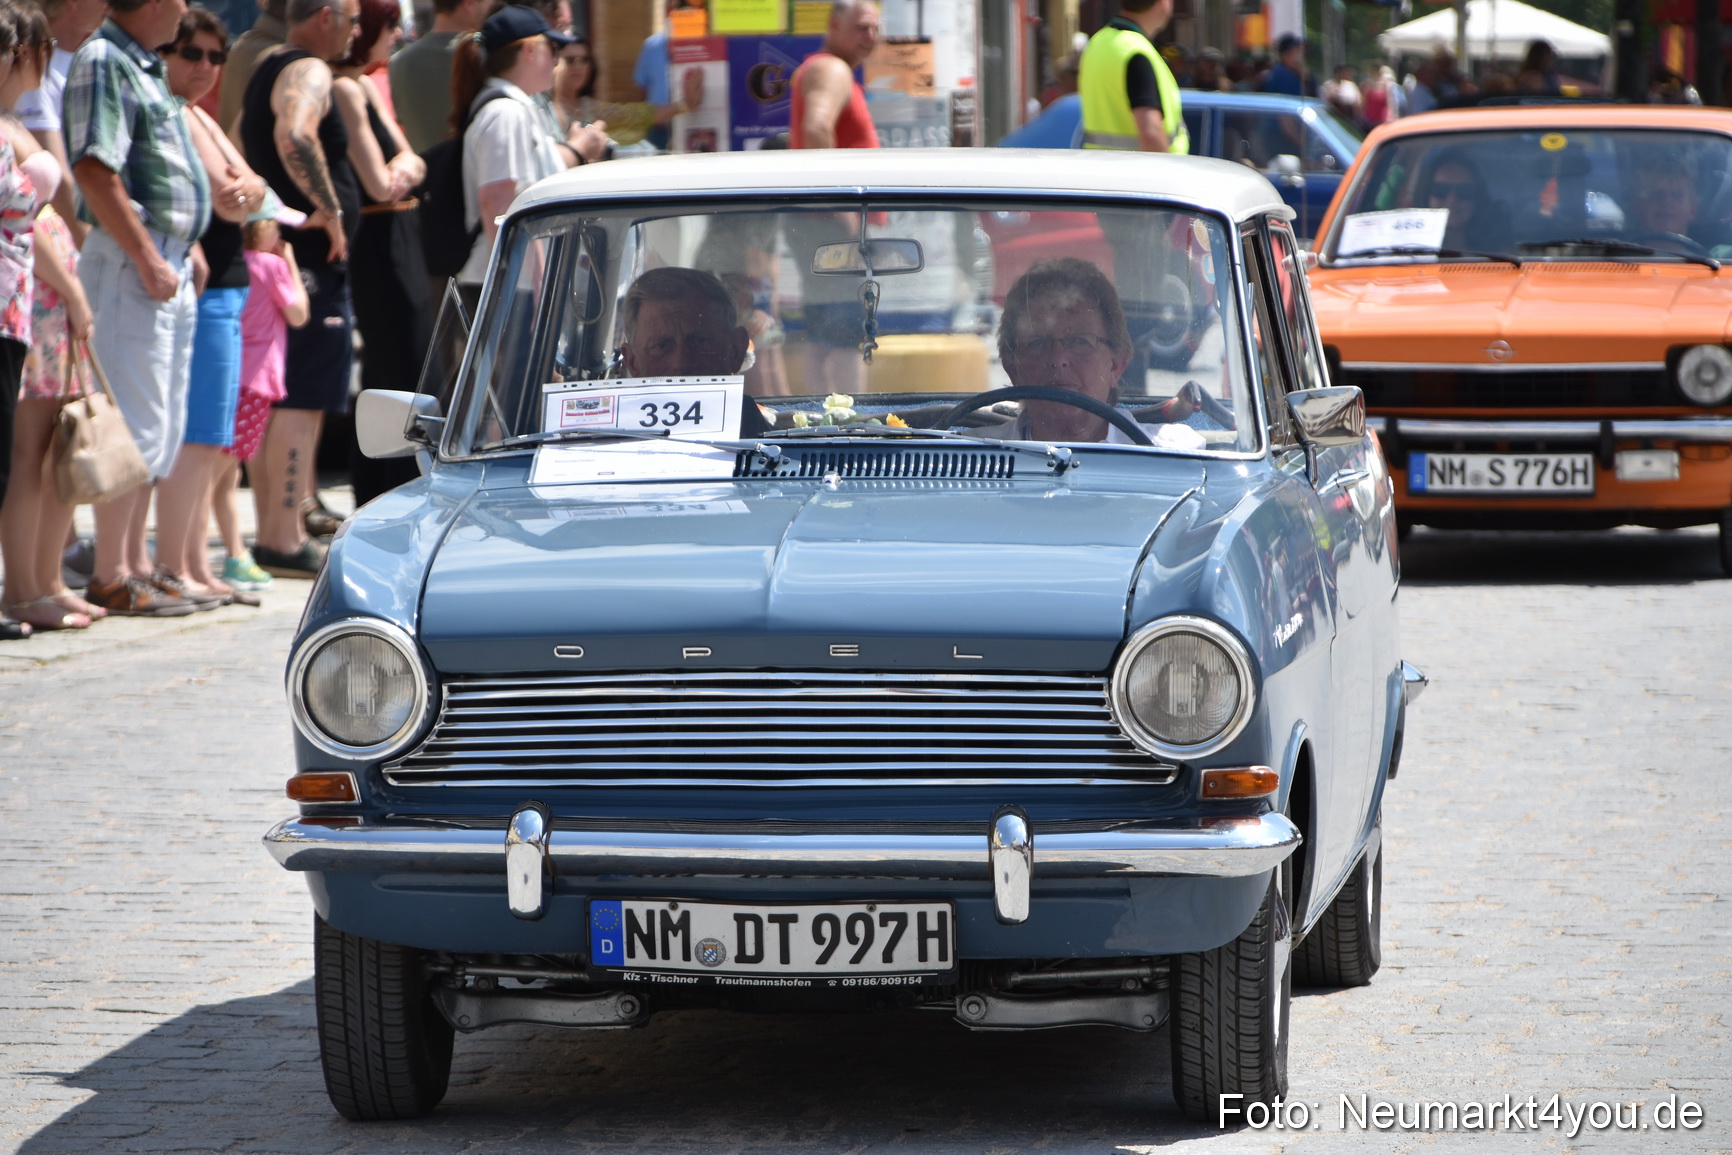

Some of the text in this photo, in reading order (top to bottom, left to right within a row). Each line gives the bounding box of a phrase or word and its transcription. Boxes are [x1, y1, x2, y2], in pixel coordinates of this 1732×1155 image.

[639, 400, 703, 427] 334
[1428, 458, 1466, 485] NM
[1488, 458, 1506, 486] S
[1514, 458, 1589, 486] 776H
[553, 644, 984, 659] OPEL
[601, 939, 613, 954] D
[625, 908, 691, 962] NM
[733, 912, 798, 965] DT
[812, 910, 949, 965] 997H
[623, 972, 641, 982] Kfz
[650, 974, 699, 984] Tischner
[715, 976, 812, 987] Trautmannshofen
[842, 976, 922, 987] 09186/909154
